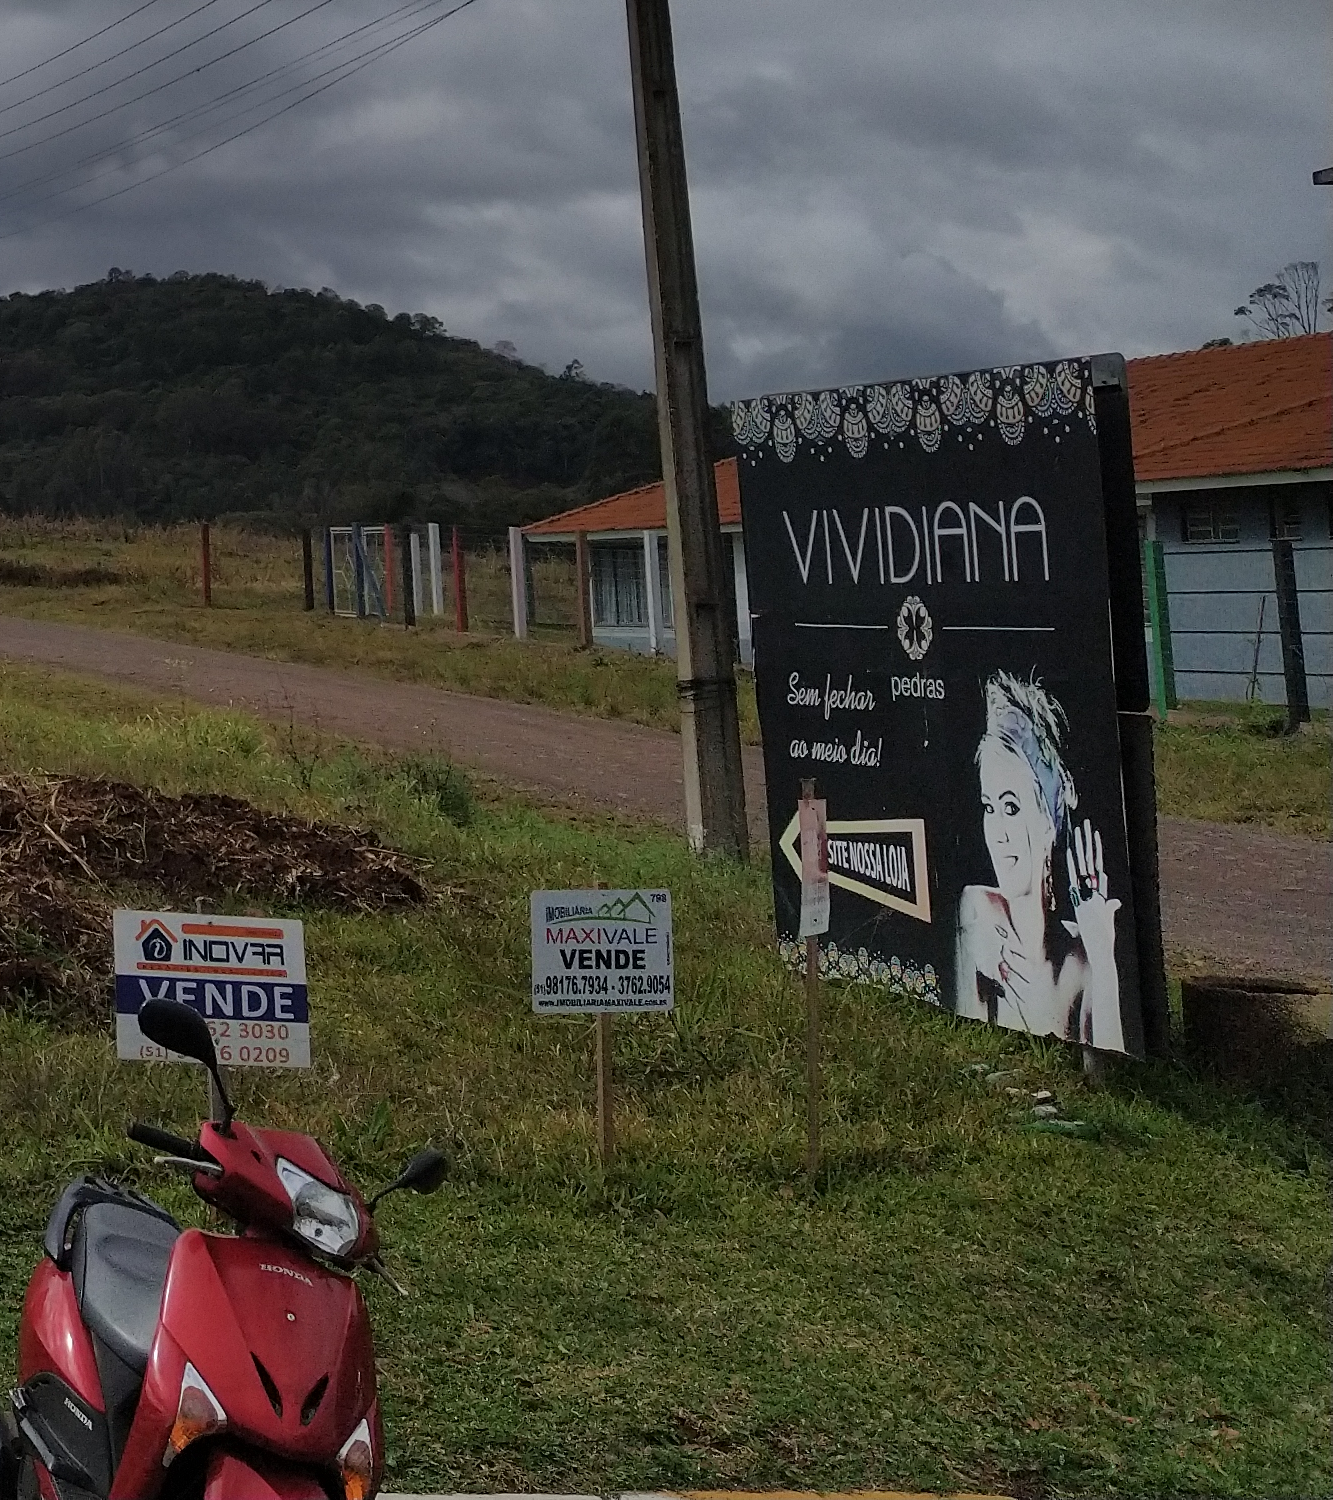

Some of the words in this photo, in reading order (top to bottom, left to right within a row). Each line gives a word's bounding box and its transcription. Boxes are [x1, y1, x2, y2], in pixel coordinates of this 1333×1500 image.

[782, 496, 1050, 585] VIVIDIANA
[787, 671, 822, 706] Sem
[824, 673, 876, 721] fechar
[890, 671, 946, 702] pedras
[789, 739, 809, 759] ao
[811, 737, 848, 764] meio
[850, 729, 883, 767] dia!
[827, 838, 850, 870] SITE
[848, 840, 884, 883] NOSSA
[882, 844, 912, 893] LOJA
[545, 927, 659, 945] MAXIVALE
[559, 948, 647, 970] VENDE
[206, 1020, 231, 1038] 62
[238, 1022, 290, 1041] 3030
[139, 1045, 169, 1060] (51)
[239, 1046, 291, 1064] 0209
[258, 1262, 314, 1288] HONDA
[63, 1397, 93, 1431] HONDA
